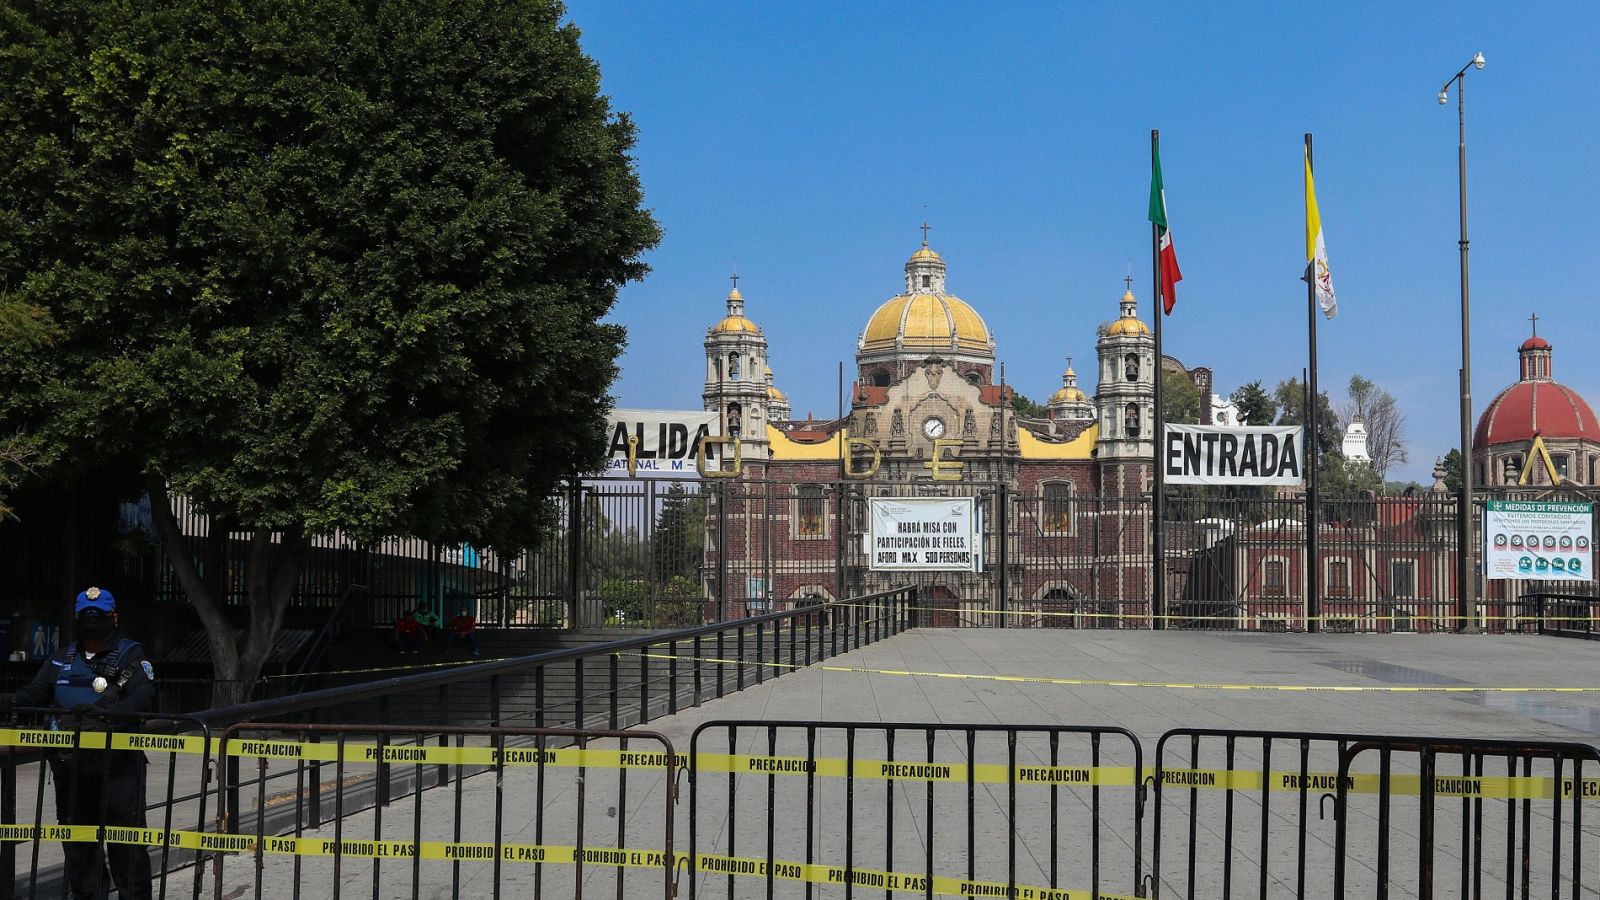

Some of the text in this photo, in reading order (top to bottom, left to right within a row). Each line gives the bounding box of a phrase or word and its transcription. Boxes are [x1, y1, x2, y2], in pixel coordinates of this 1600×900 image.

[608, 421, 715, 460] ALIDA
[1166, 431, 1299, 477] ENTRADA
[606, 459, 660, 470] EATNAL
[1505, 503, 1590, 513] MEDIDAS DE PREVENCIÓN
[897, 520, 957, 534] HABRÁ MISA CON
[877, 535, 930, 549] PARTICIPACIÓN
[932, 536, 941, 549] DE
[877, 551, 897, 563] AFORO
[925, 551, 938, 563] 500
[939, 551, 970, 564] PERSONAS
[129, 736, 185, 750] PRECAUCION
[241, 742, 302, 757] PRECAUCION
[366, 748, 427, 761] PRCAUCION
[492, 751, 556, 763] PECAUCON
[620, 753, 687, 767] PRECAUCON
[881, 764, 950, 779] PRECAUCION
[1020, 768, 1089, 782] PRECAUCION
[1161, 770, 1215, 786] PRECAUCION
[1436, 779, 1481, 794] ECAUCION
[50, 828, 71, 840] PASO
[143, 831, 153, 843] EL
[157, 832, 181, 845] PSO
[271, 839, 296, 853] PASO
[322, 842, 374, 856] PRHIBIDO
[377, 844, 388, 856] EL
[393, 844, 416, 857] PAS
[445, 845, 495, 858] PROHIBID
[504, 847, 514, 859] EL
[518, 847, 545, 861] PASO
[631, 852, 642, 865] EL
[702, 857, 755, 874] PROHIBIDO
[775, 863, 801, 879] PASO
[887, 875, 899, 889] EL
[904, 877, 932, 891] PAS
